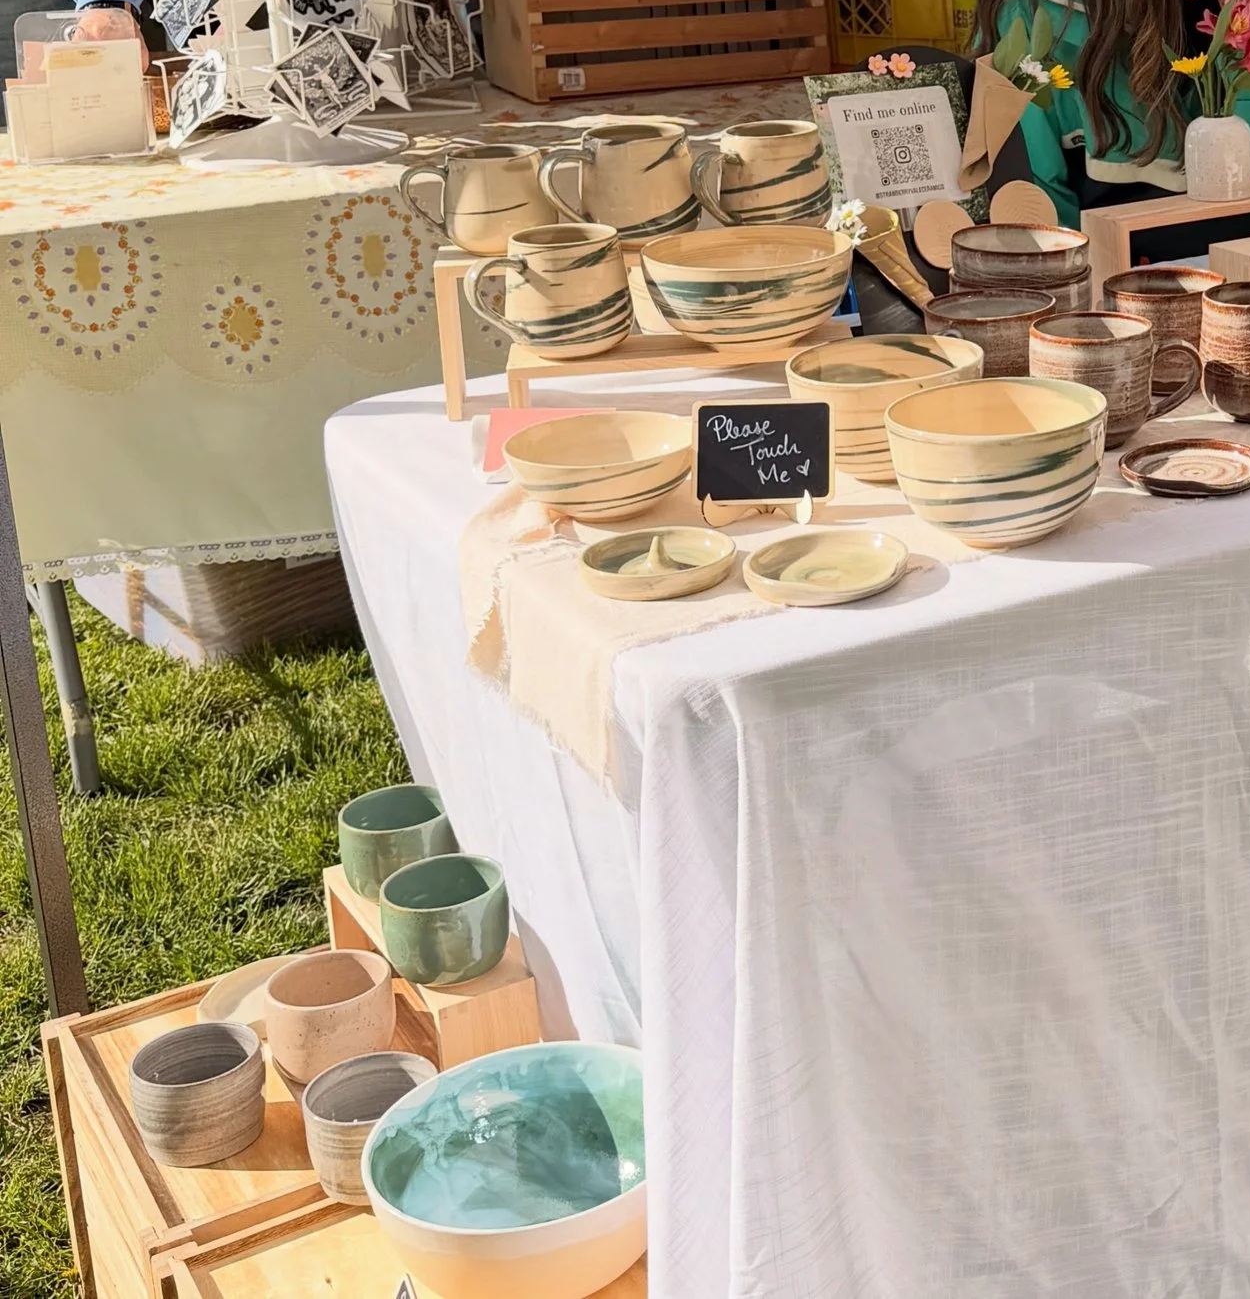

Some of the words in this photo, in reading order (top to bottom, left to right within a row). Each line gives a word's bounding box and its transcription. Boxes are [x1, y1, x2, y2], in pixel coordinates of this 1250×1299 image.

[842, 106, 873, 123] Find
[876, 108, 896, 119] me
[899, 101, 936, 116] online
[706, 414, 775, 443] Please
[730, 433, 801, 466] Touch
[757, 463, 791, 485] Me
